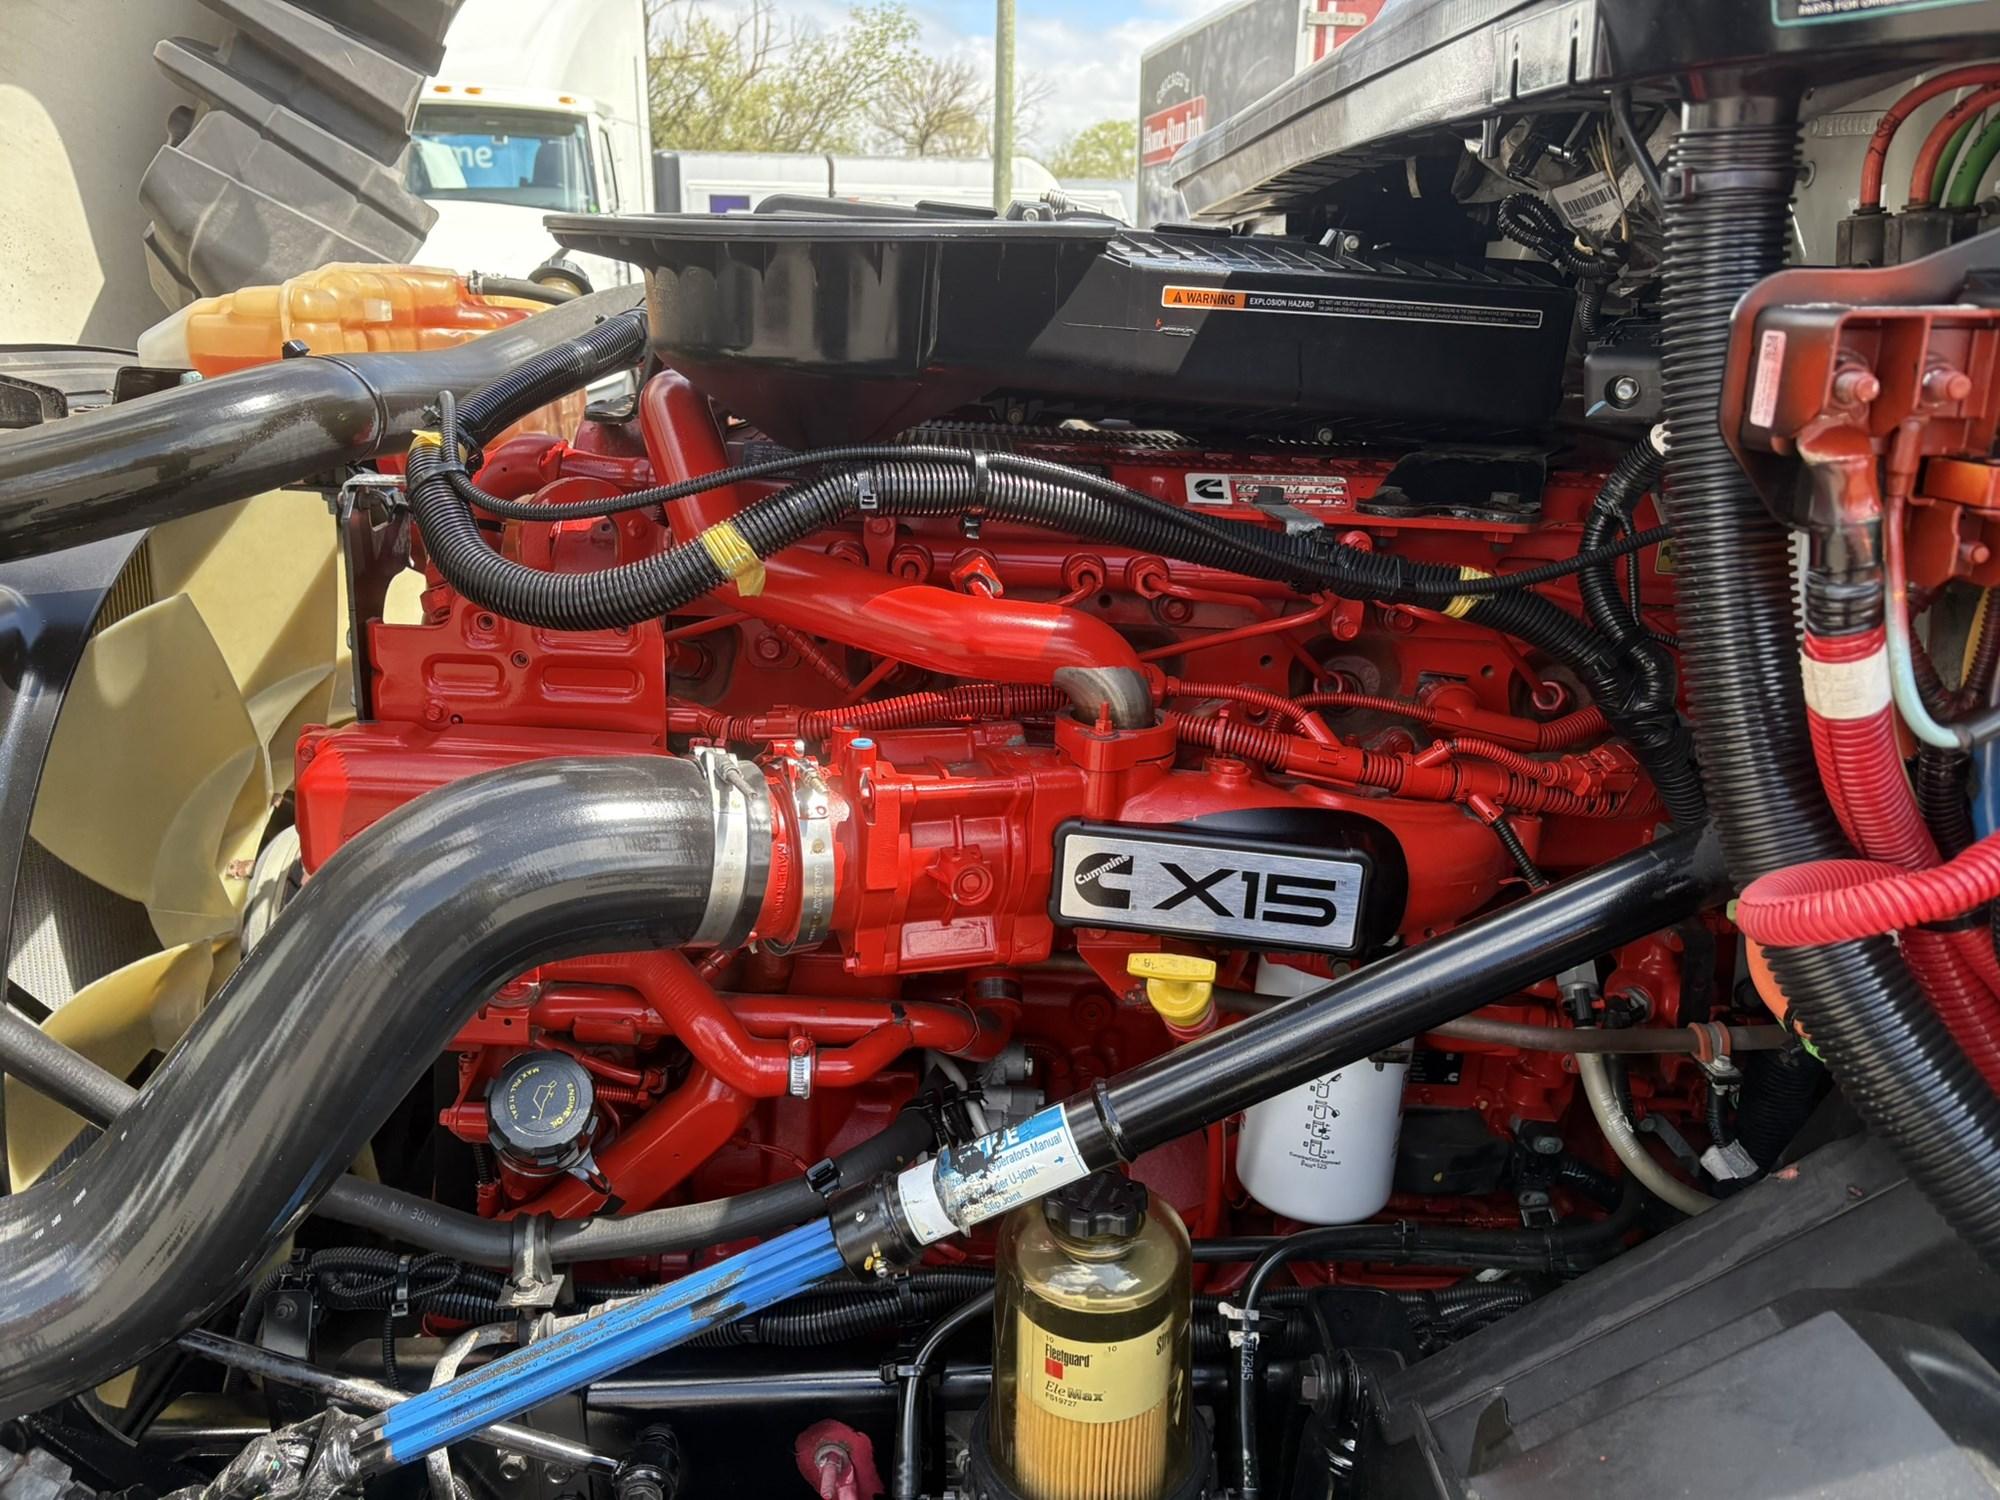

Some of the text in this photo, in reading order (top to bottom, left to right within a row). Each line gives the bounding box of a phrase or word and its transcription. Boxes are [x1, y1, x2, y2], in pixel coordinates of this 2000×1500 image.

[1186, 292, 1316, 309] WARNING EXPLOSION HAZARD
[1075, 855, 1130, 885] Cummins
[1153, 862, 1338, 928] X15
[521, 1067, 540, 1078] MAX
[550, 1083, 576, 1128] ENGINE OIL
[1031, 1134, 1063, 1154] Manual
[1009, 1164, 1039, 1185] U-joint
[1046, 1335, 1055, 1344] 10
[1045, 1343, 1091, 1368] Fleetguard
